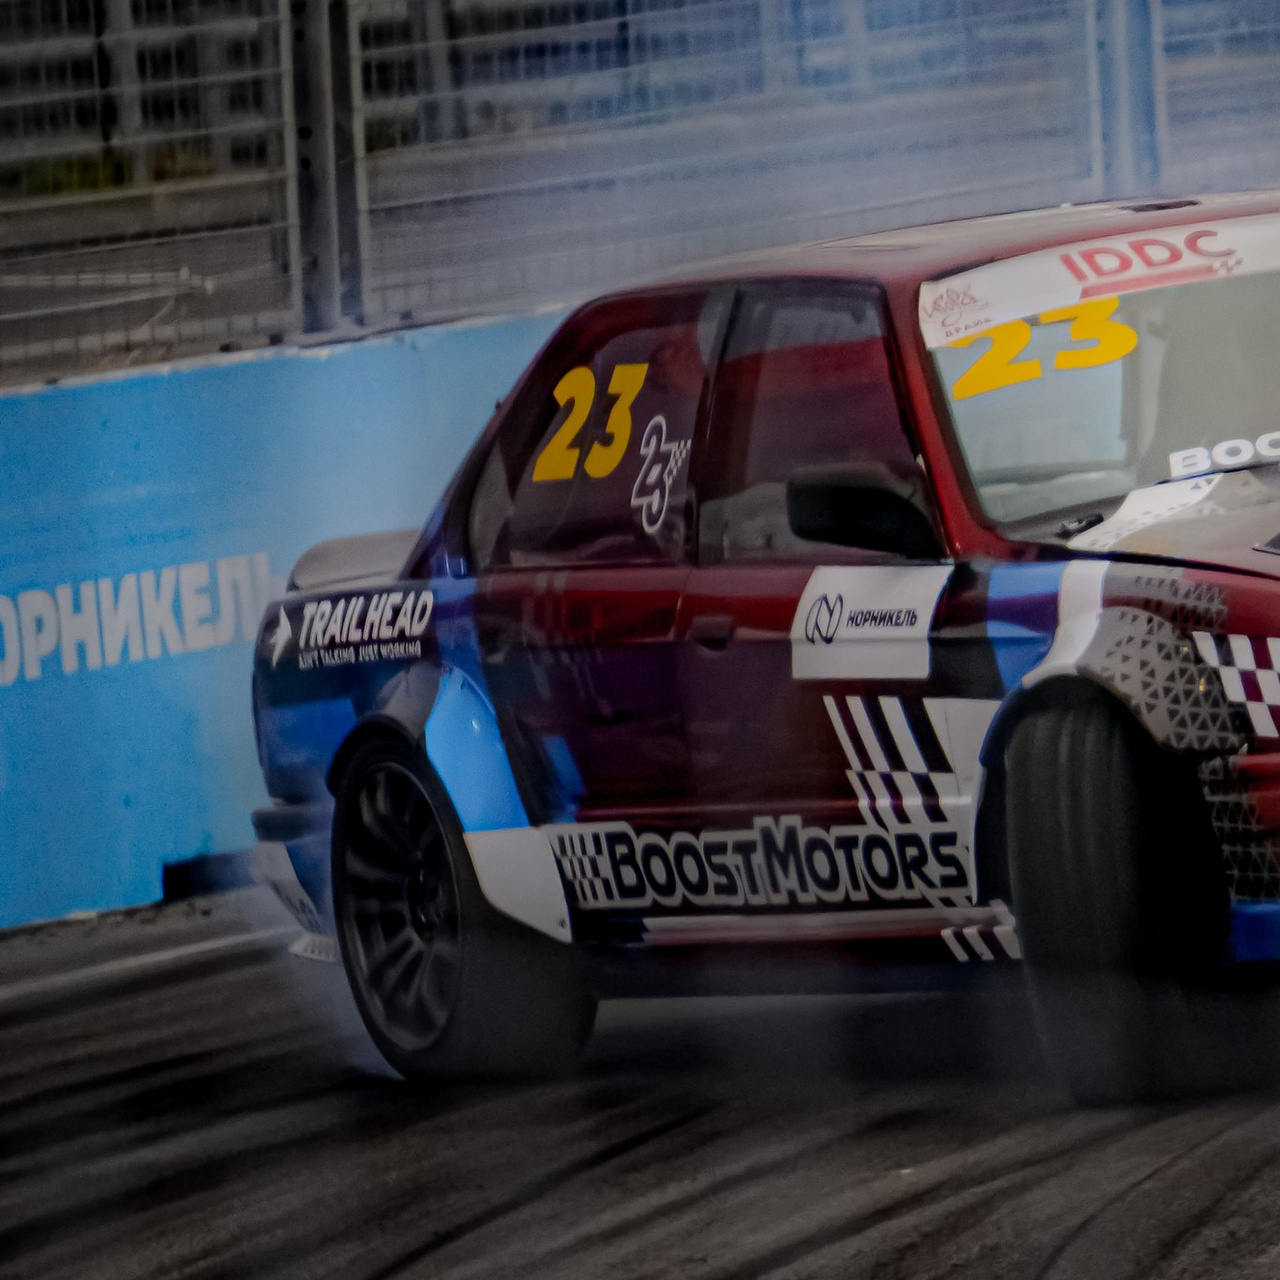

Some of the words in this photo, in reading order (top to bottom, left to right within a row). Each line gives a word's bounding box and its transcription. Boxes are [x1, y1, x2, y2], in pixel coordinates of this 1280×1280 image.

[1060, 229, 1237, 282] IDDC
[946, 295, 1138, 401] 23
[532, 363, 649, 482] 23
[300, 590, 434, 649] TRAILHEAD
[846, 608, 917, 627] НОРНИКЕЛЬ
[359, 644, 379, 663] JUST
[380, 639, 422, 660] WORKING
